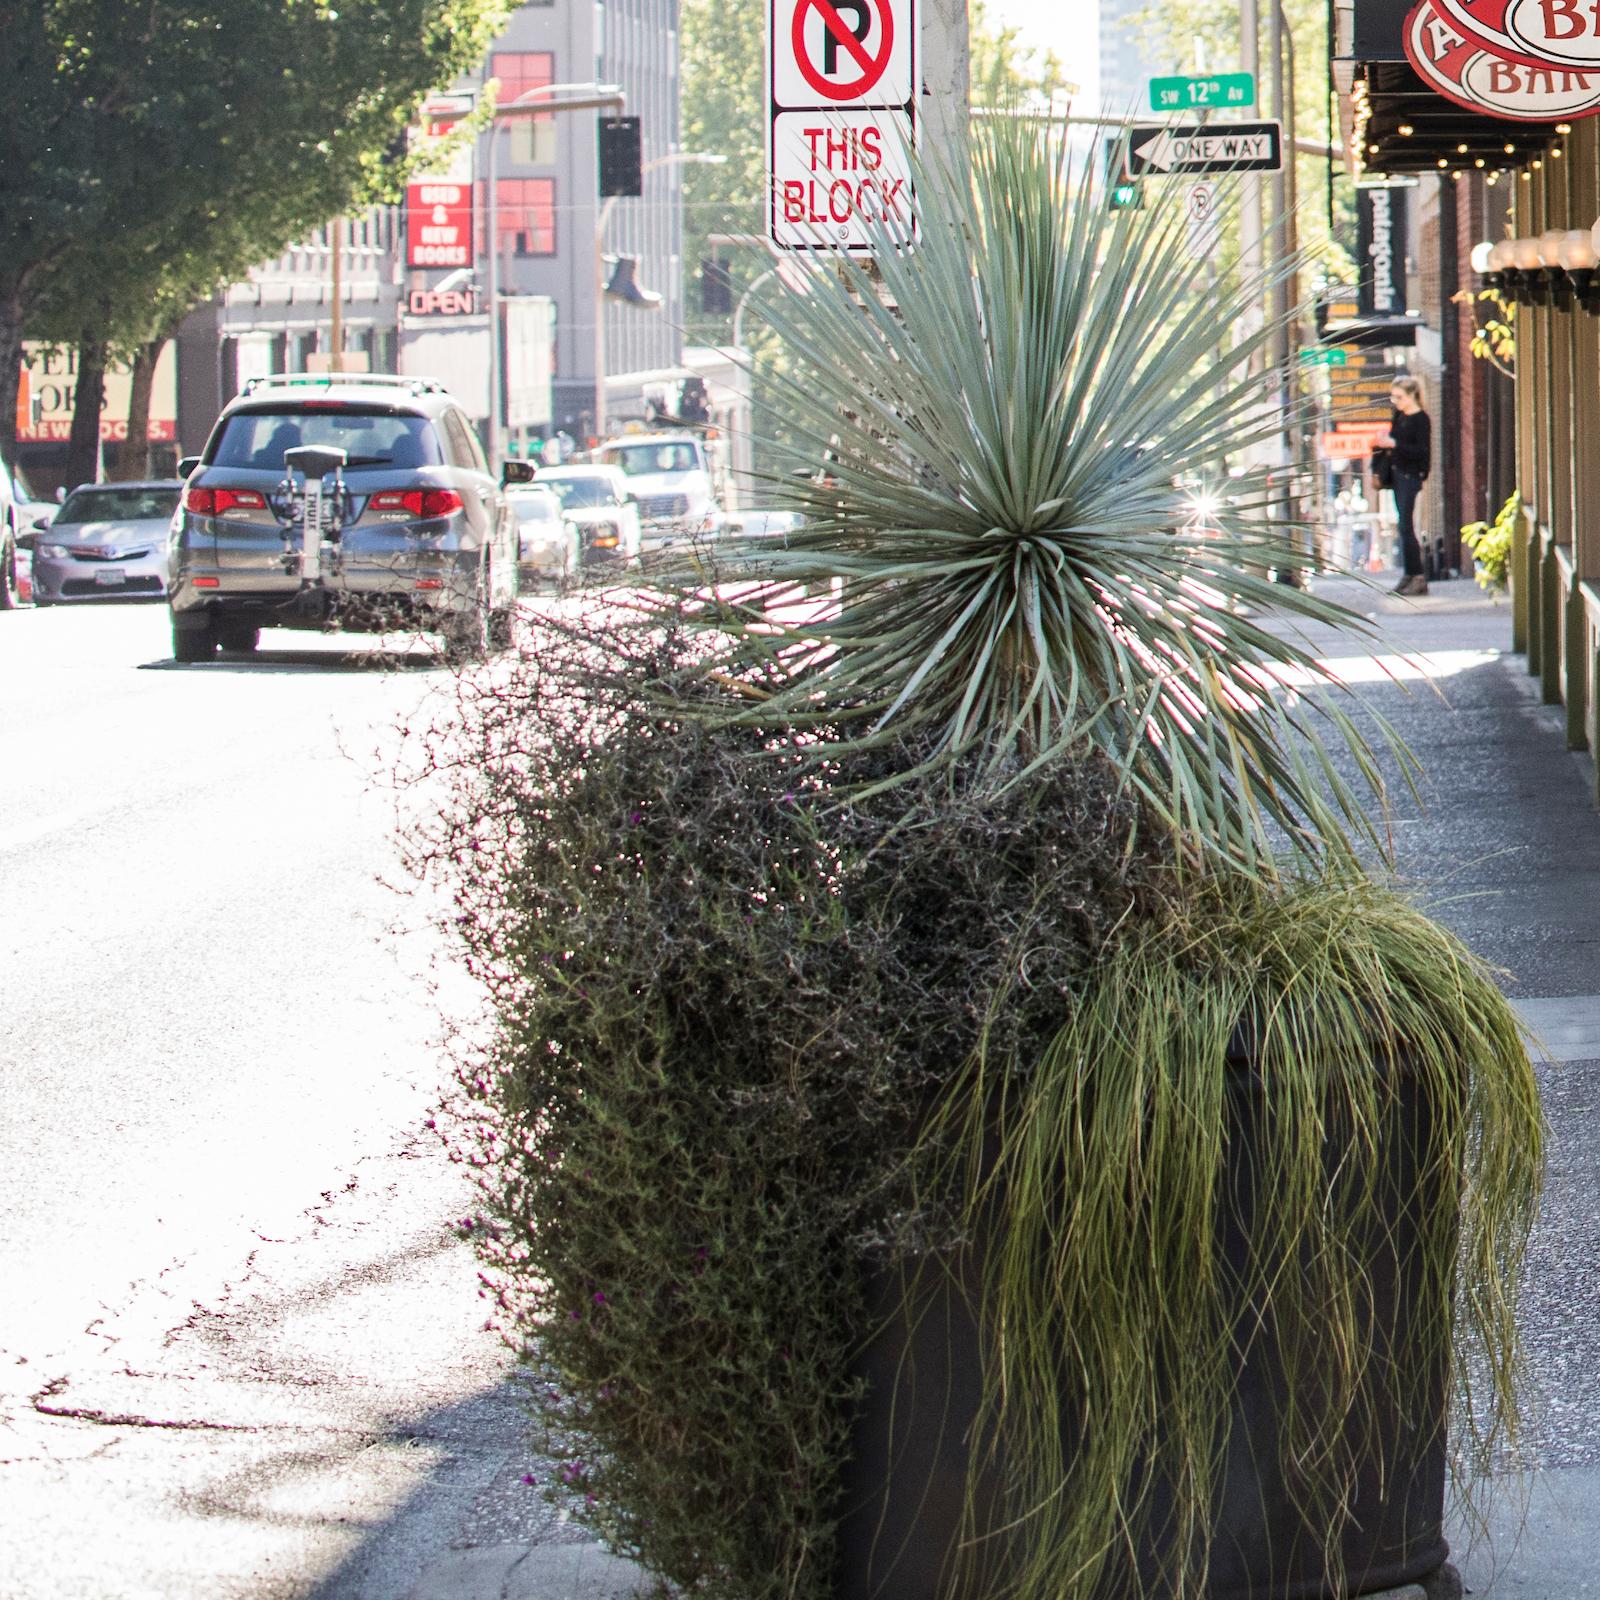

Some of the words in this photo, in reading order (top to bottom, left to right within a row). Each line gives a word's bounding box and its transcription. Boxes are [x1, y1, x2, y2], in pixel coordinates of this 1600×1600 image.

[1160, 90, 1180, 105] SW
[1187, 82, 1220, 103] 12th
[1228, 87, 1243, 100] Av
[803, 127, 882, 171] THIS
[1174, 139, 1214, 160] ONE
[1223, 138, 1263, 157] WAY
[784, 178, 904, 224] BLOCK
[421, 225, 460, 244] NEW
[413, 245, 466, 265] BOOKS
[410, 291, 472, 315] OPEN
